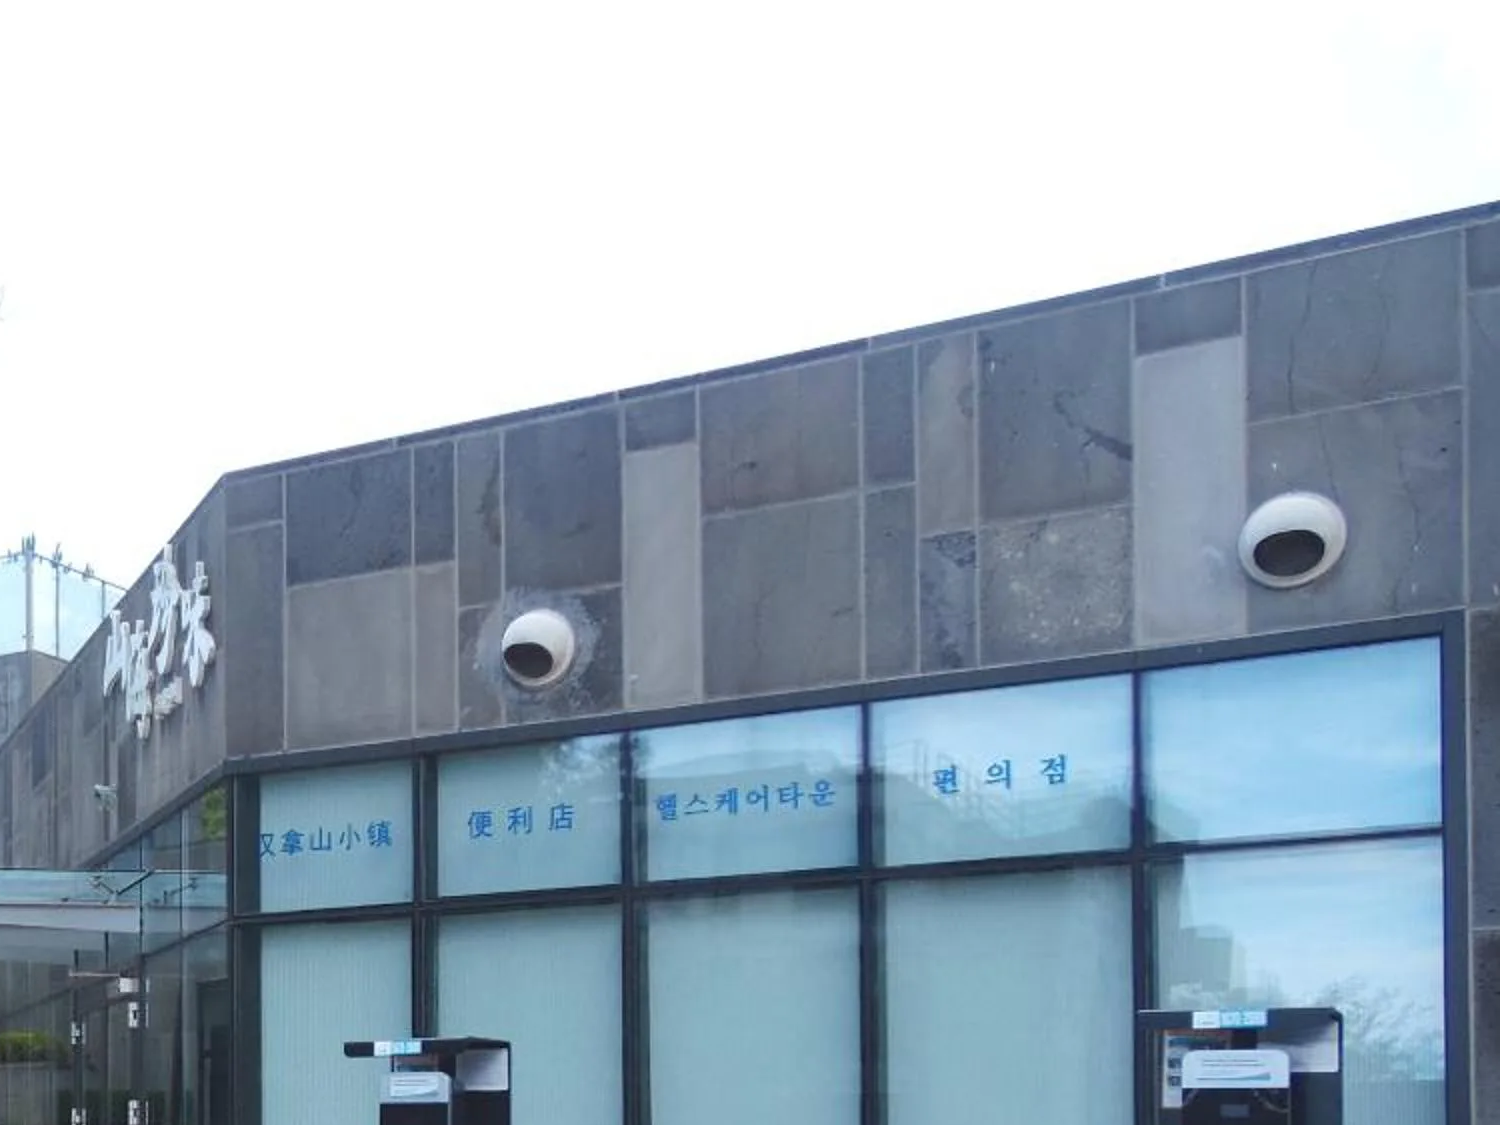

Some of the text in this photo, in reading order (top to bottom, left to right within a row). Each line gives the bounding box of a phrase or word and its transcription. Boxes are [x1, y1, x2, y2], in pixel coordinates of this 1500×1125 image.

[655, 754, 1067, 821] 헬스케어타운 편의점
[468, 802, 575, 839] 便利店
